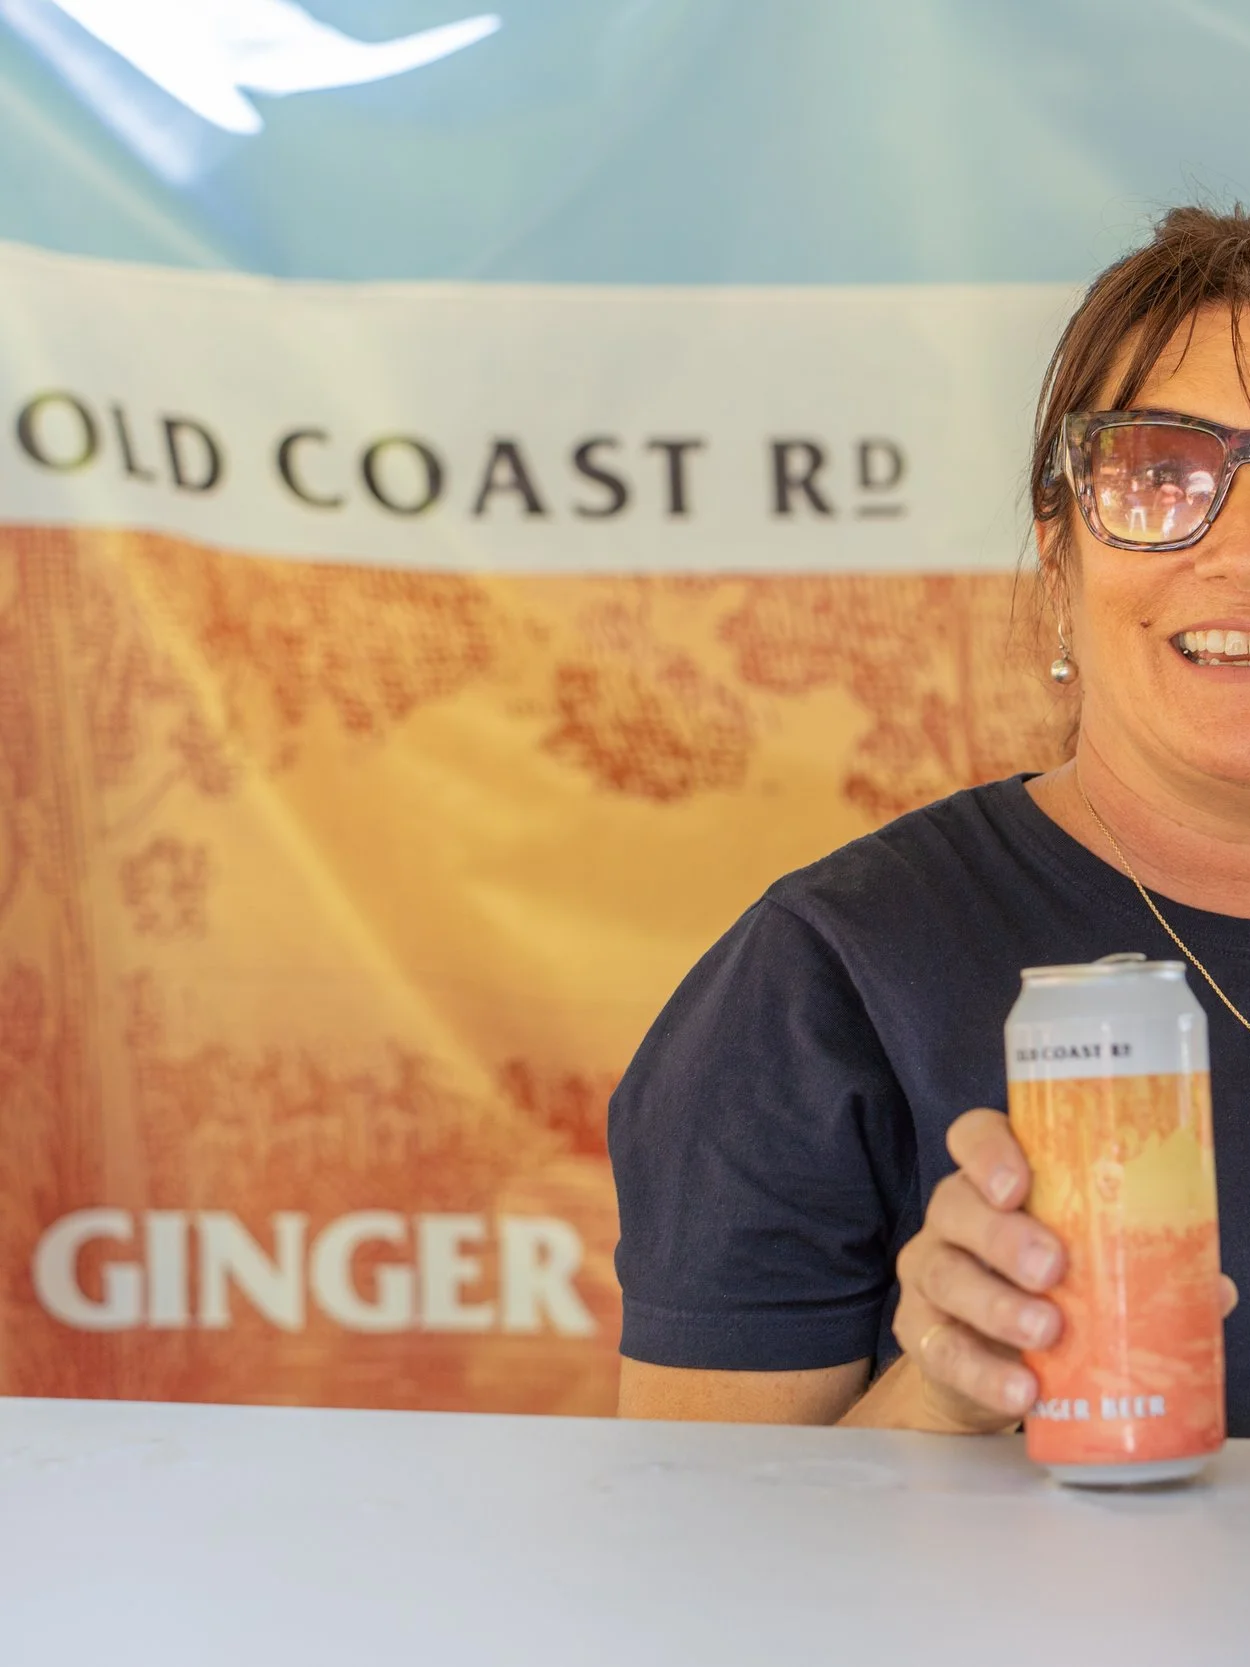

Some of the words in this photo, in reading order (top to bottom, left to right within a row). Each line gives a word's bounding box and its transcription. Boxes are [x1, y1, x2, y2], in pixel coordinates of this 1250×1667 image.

[16, 389, 222, 496] OLD
[276, 427, 706, 519] COAST
[1041, 1043, 1101, 1060] COAST
[32, 1207, 597, 1337] GINGER
[1101, 1395, 1166, 1420] BEER
